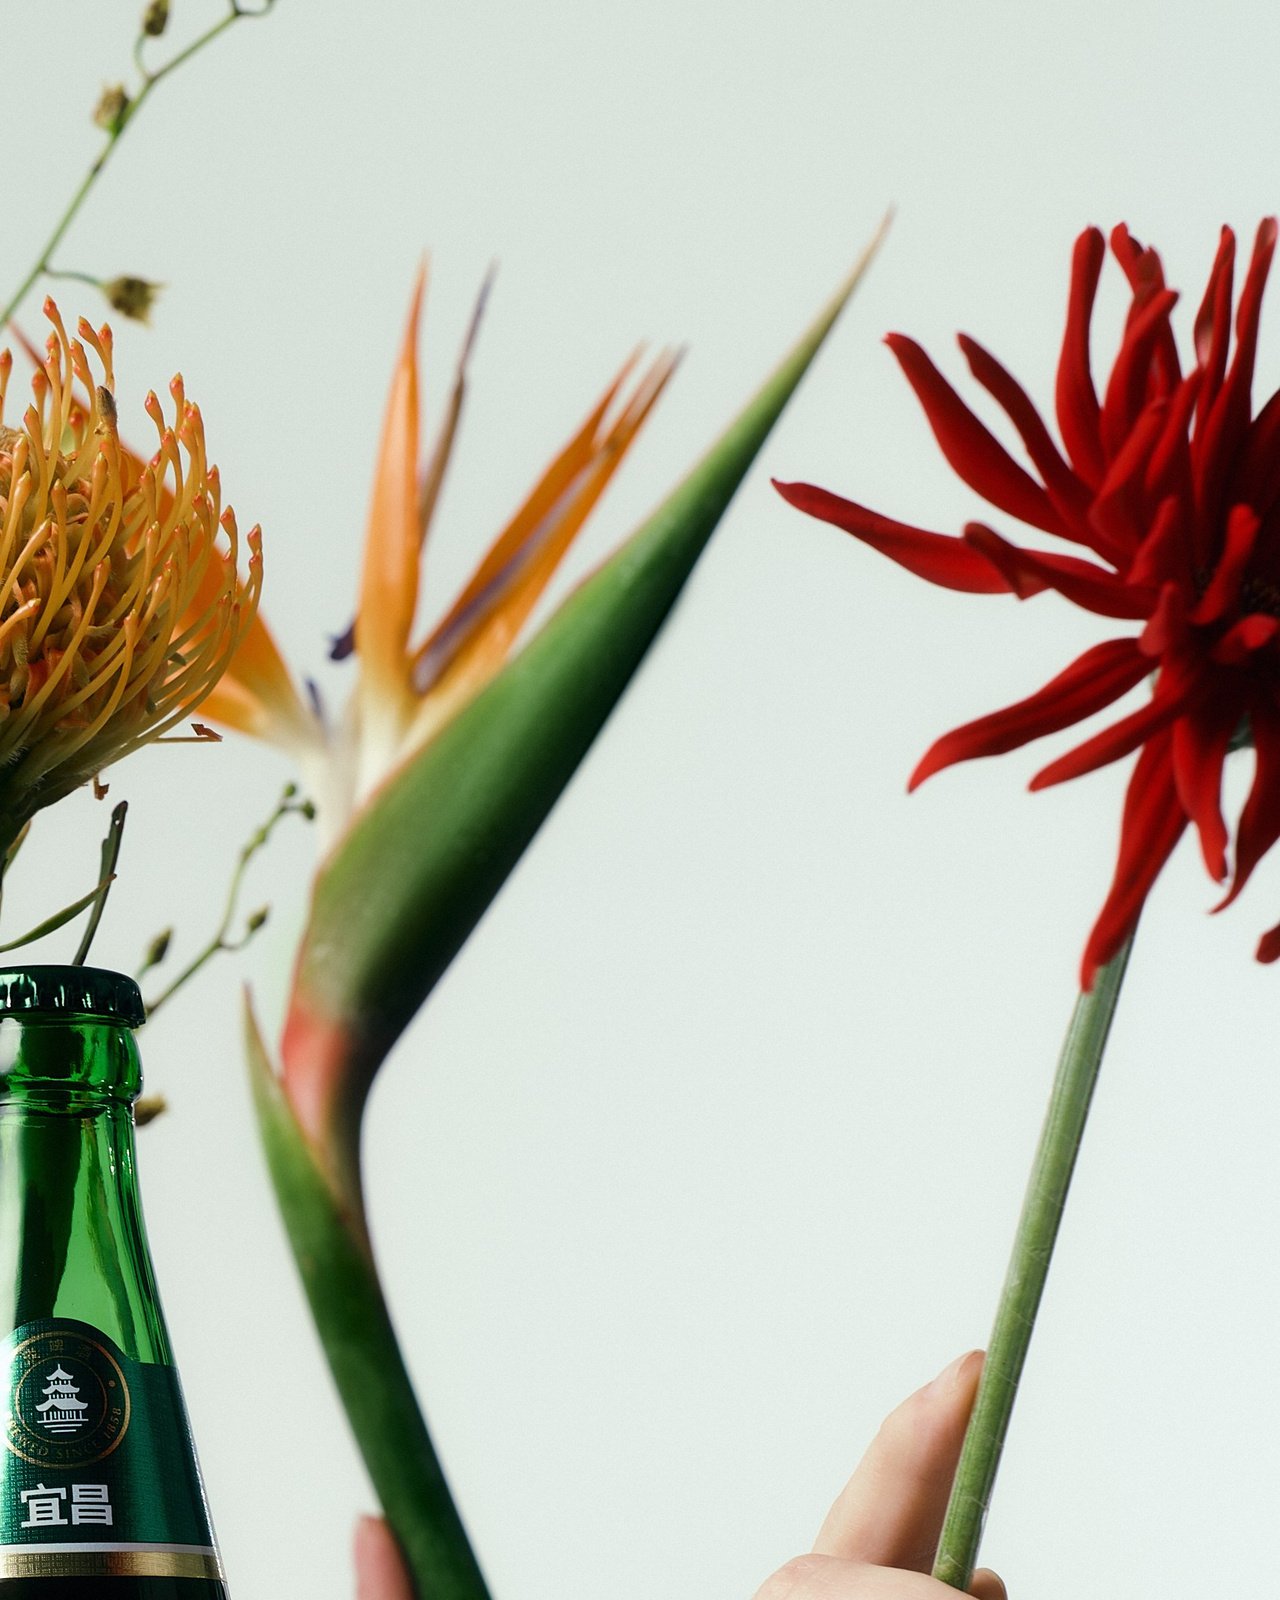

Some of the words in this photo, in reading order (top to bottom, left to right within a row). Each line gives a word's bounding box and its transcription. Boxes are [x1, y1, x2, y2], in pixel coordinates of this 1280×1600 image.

[6, 1412, 49, 1457] REWED
[103, 1407, 122, 1439] 1858
[20, 1483, 113, 1528] 宜昌
